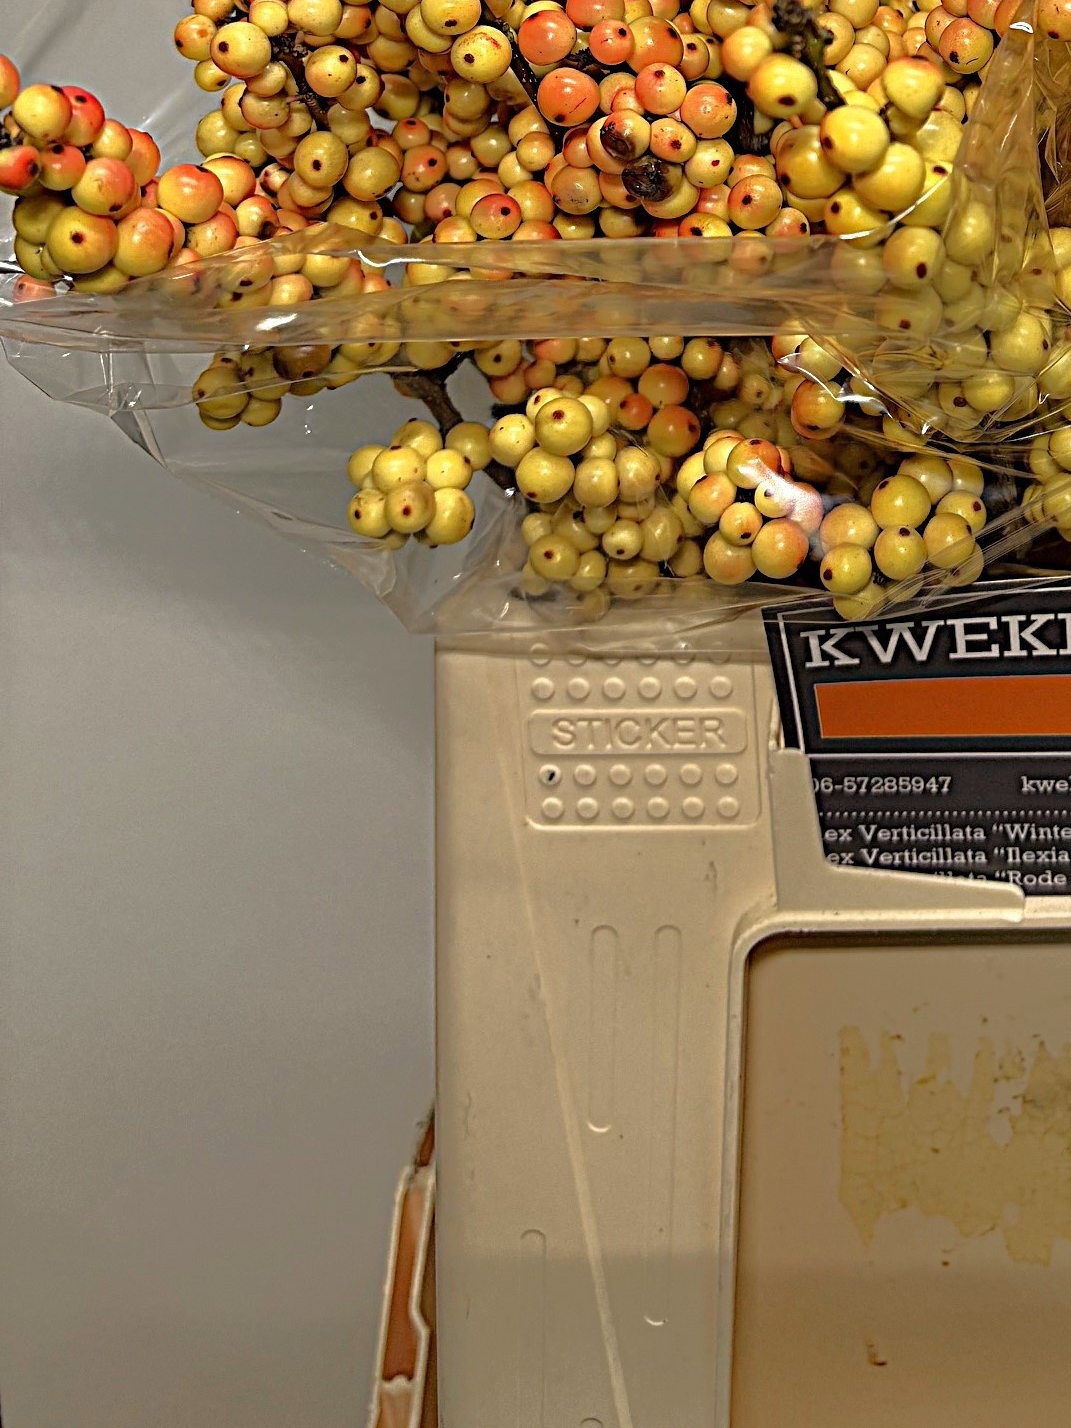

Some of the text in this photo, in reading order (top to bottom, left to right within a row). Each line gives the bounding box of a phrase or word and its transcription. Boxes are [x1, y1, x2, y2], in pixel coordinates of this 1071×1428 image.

[550, 715, 727, 750] STICKER
[824, 828, 853, 842] ex
[858, 824, 986, 842] Verticillata
[827, 852, 855, 865] ex
[860, 847, 988, 866] Verticillata
